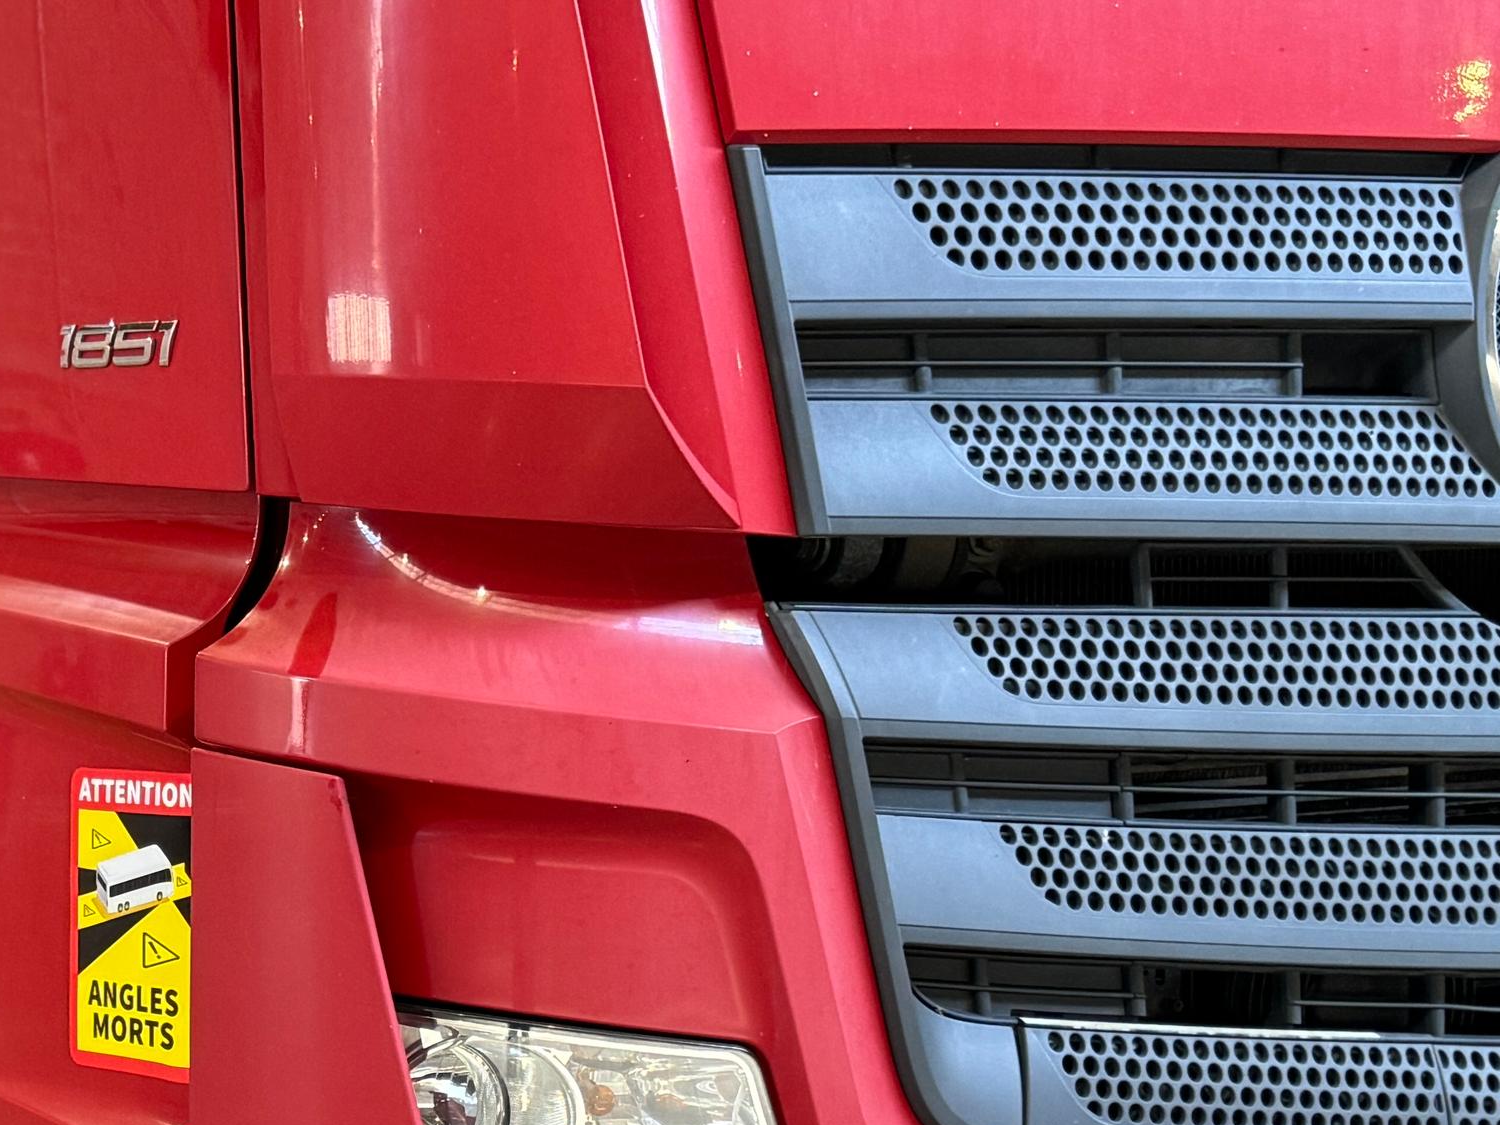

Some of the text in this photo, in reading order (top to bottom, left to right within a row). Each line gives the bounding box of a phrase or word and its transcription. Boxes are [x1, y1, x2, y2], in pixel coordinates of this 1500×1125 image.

[59, 318, 179, 368] 1851
[78, 777, 192, 808] ATTENTION
[88, 980, 179, 1017] ANGLES
[93, 1012, 174, 1050] MORTS
